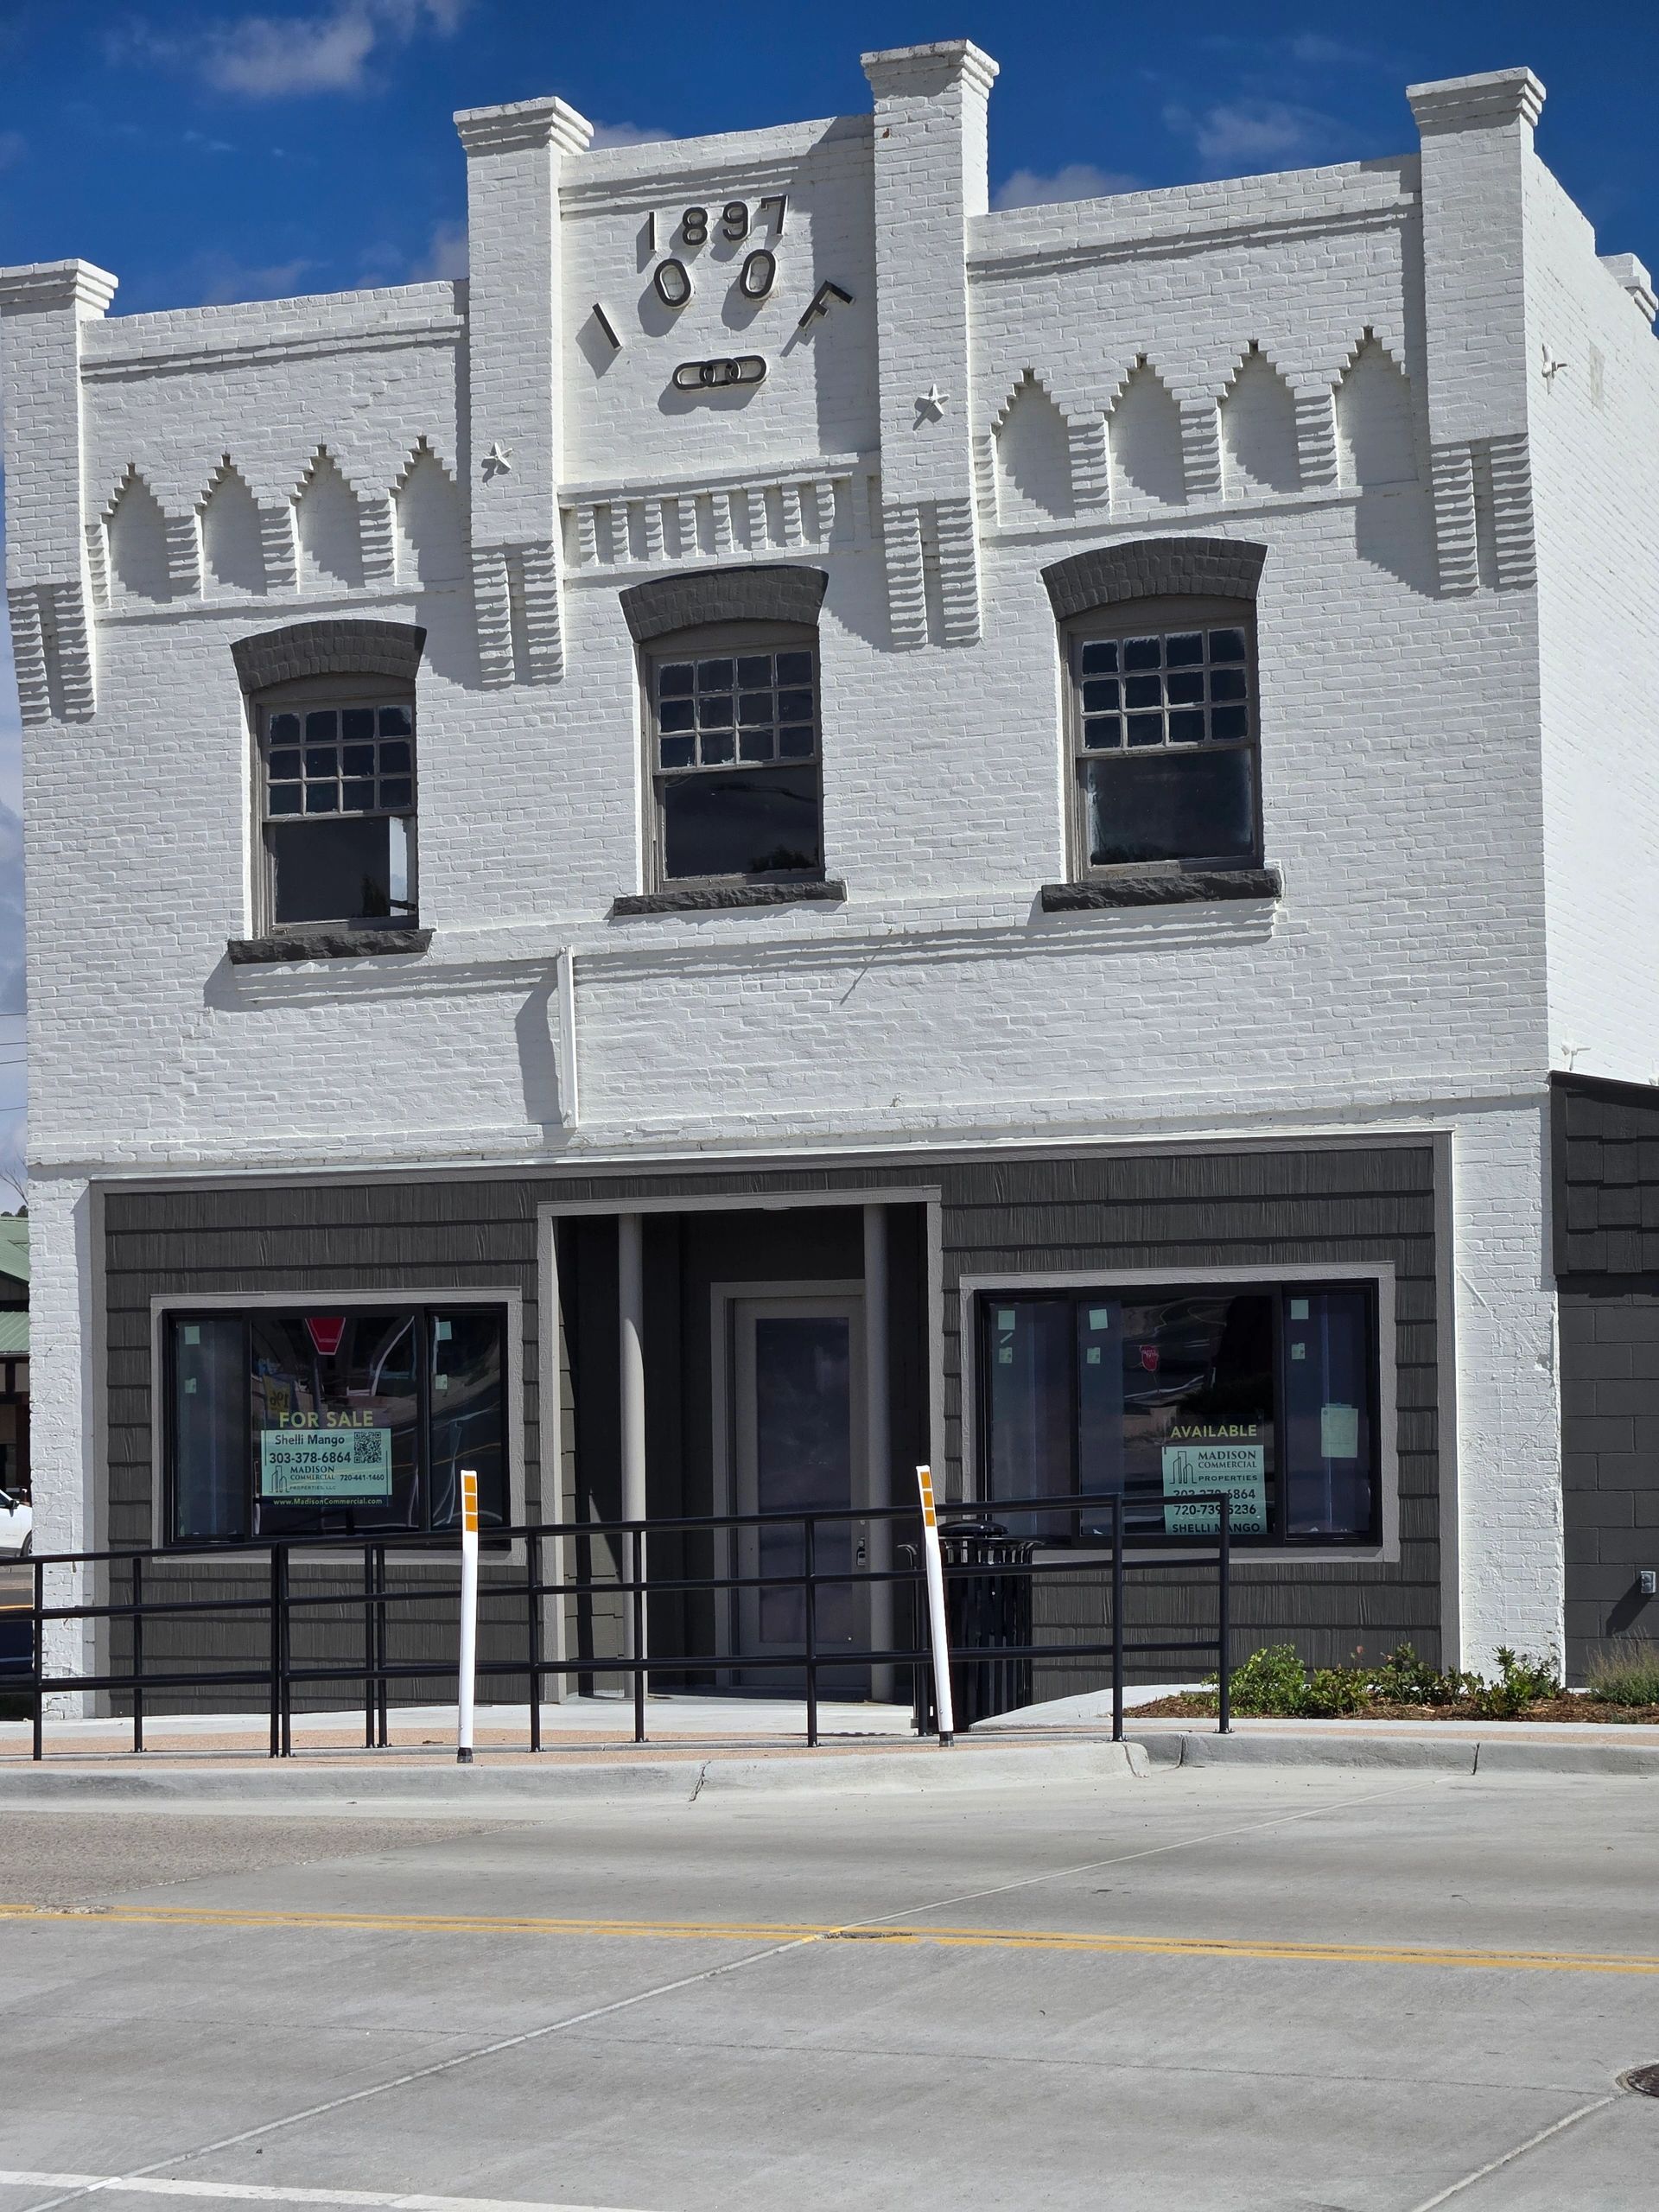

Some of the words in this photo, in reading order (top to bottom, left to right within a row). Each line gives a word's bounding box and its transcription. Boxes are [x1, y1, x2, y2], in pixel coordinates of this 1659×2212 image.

[649, 194, 787, 252] 1897
[279, 1412, 319, 1427] FOR
[327, 1410, 374, 1427] SALE
[1170, 1424, 1257, 1439] AVAILABLE
[275, 1434, 303, 1445] Shelli
[308, 1434, 345, 1447] Mango
[269, 1452, 351, 1464] 303-378-6864
[1198, 1451, 1256, 1460] MADISON
[1173, 1504, 1257, 1515] 720-7395236
[1172, 1523, 1211, 1533] SHELLI
